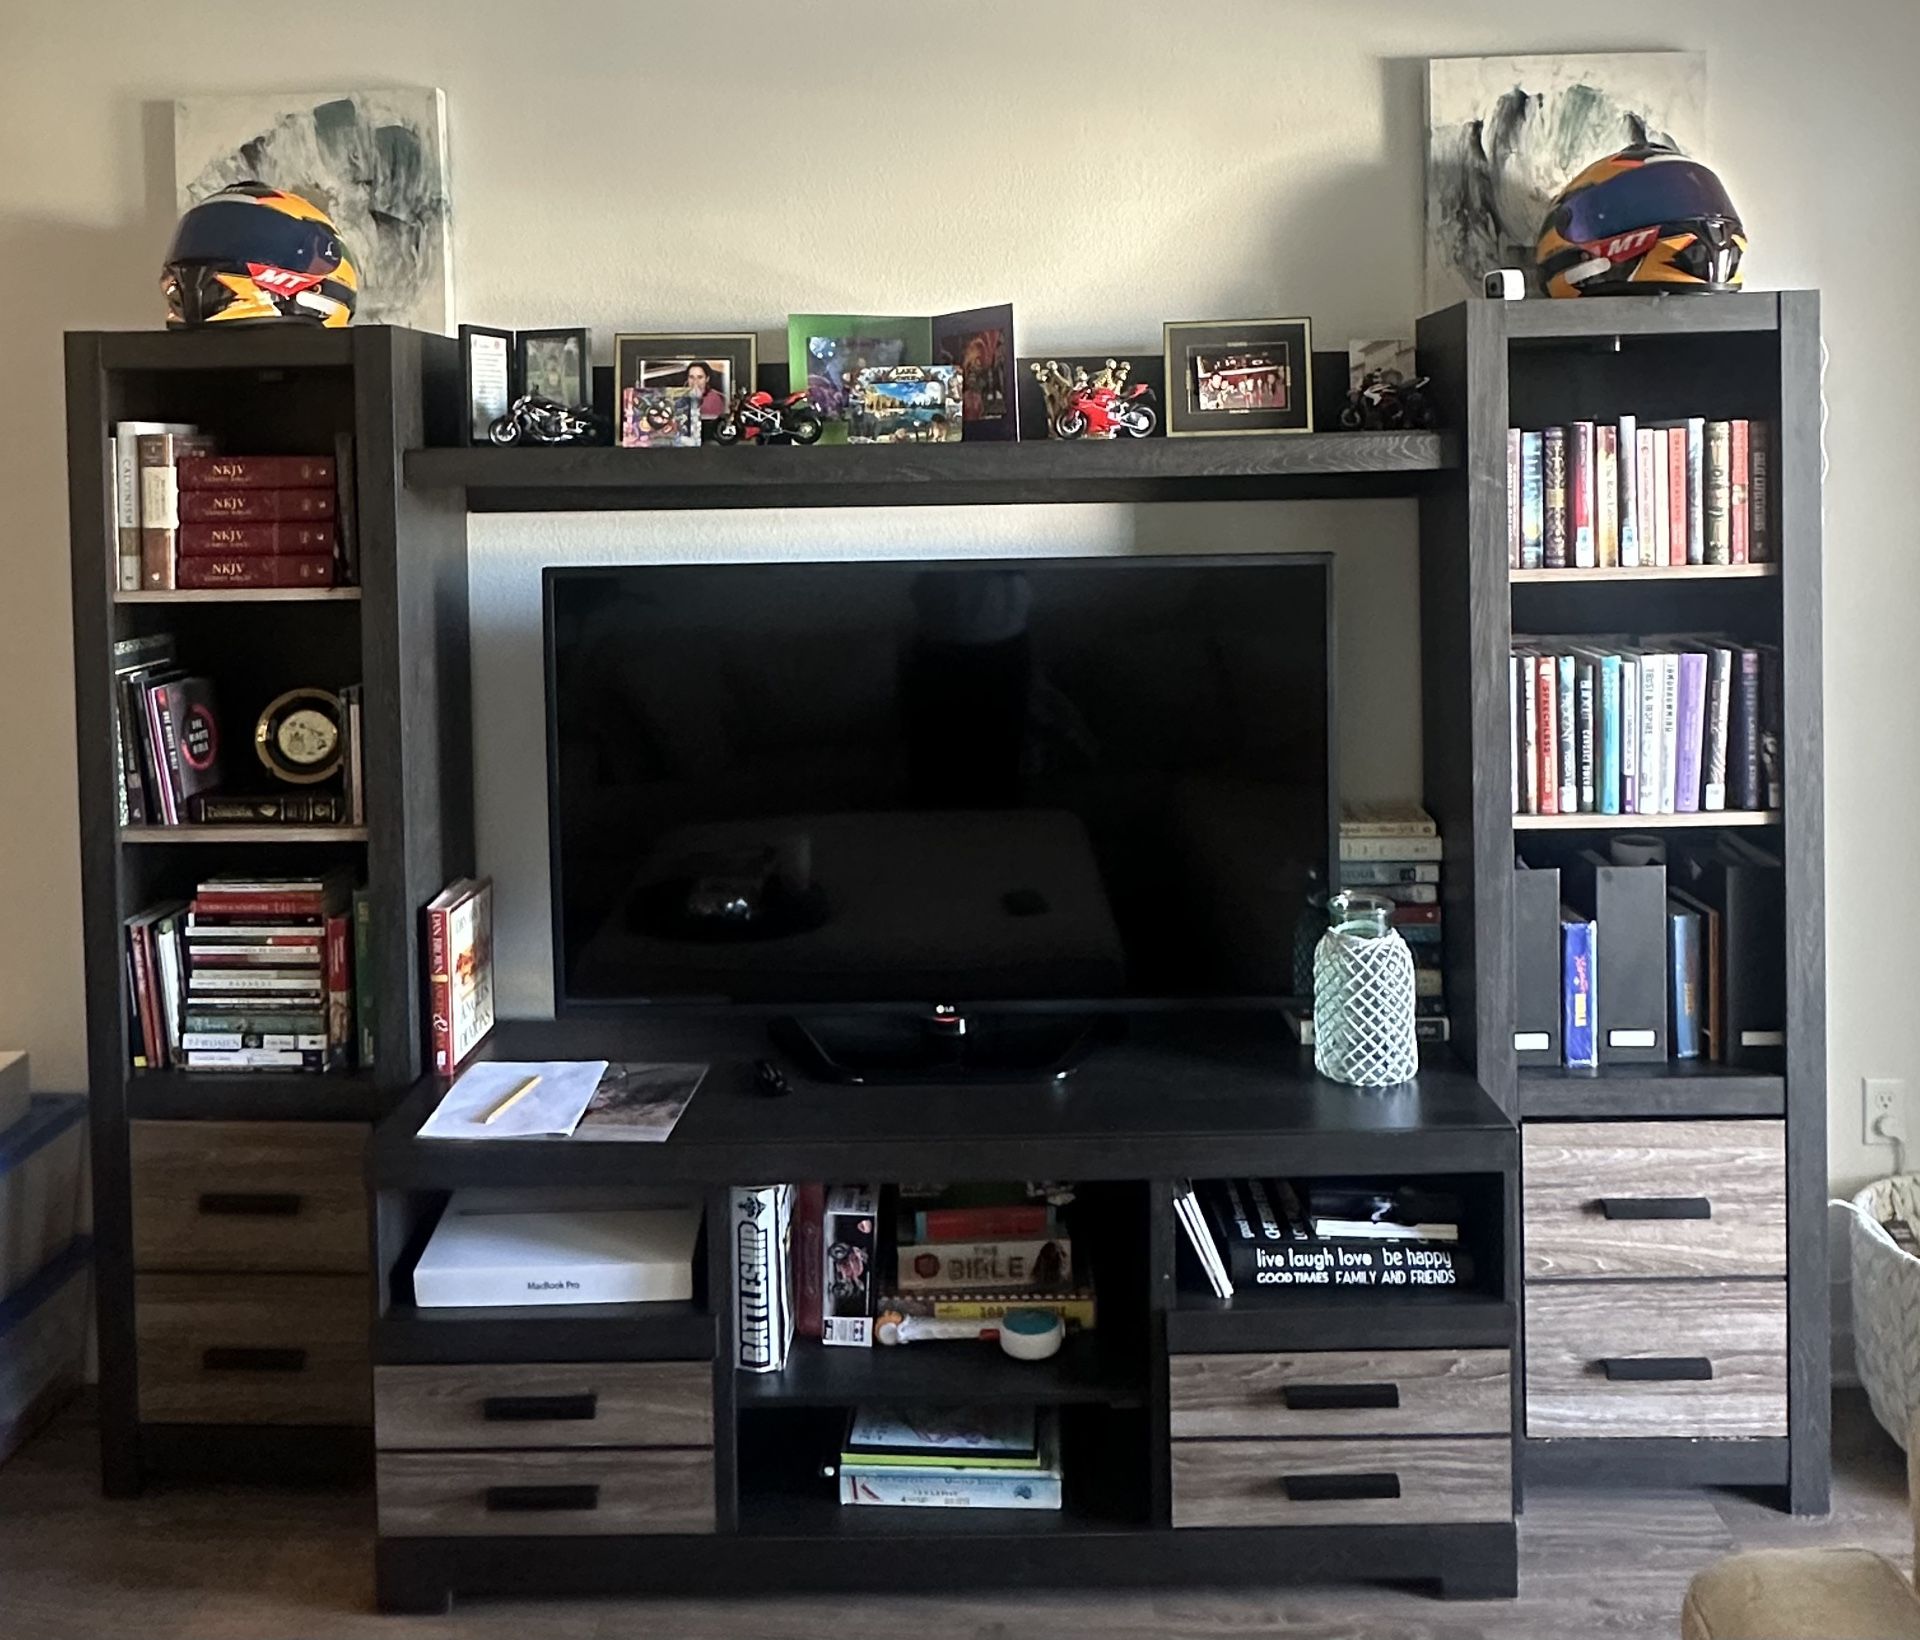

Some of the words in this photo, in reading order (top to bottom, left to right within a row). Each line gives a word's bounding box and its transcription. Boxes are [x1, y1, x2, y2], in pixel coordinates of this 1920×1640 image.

[1608, 230, 1653, 257] MT
[255, 269, 309, 289] MT
[1673, 433, 1681, 463] CRAZY
[213, 464, 246, 478] NKJV
[123, 459, 133, 525] CALVINISM
[213, 497, 246, 511] NKJV
[212, 530, 245, 544] NKJV
[212, 563, 245, 577] NKJV
[162, 710, 170, 724] ONE
[1542, 686, 1550, 753] SPEECHLESS
[165, 725, 175, 749] MINUTE
[169, 751, 178, 770] BIBLE
[432, 913, 444, 936] DAN
[432, 938, 444, 974] BROWN
[974, 1246, 998, 1256] THE
[1256, 1248, 1285, 1267] live
[1288, 1247, 1334, 1270] laugh
[1338, 1247, 1372, 1267] love
[1382, 1247, 1403, 1266] be
[1406, 1248, 1452, 1268] happy
[949, 1257, 1024, 1280] BIBLE
[1256, 1272, 1293, 1284] GOOD
[1295, 1271, 1329, 1283] TIMES
[1335, 1271, 1376, 1284] FAMILY
[1381, 1271, 1406, 1284] AND
[1410, 1270, 1456, 1284] FRIENDS
[527, 1281, 564, 1291] MacBook
[566, 1281, 580, 1290] Pro
[739, 1221, 769, 1366] BATTLESHIP
